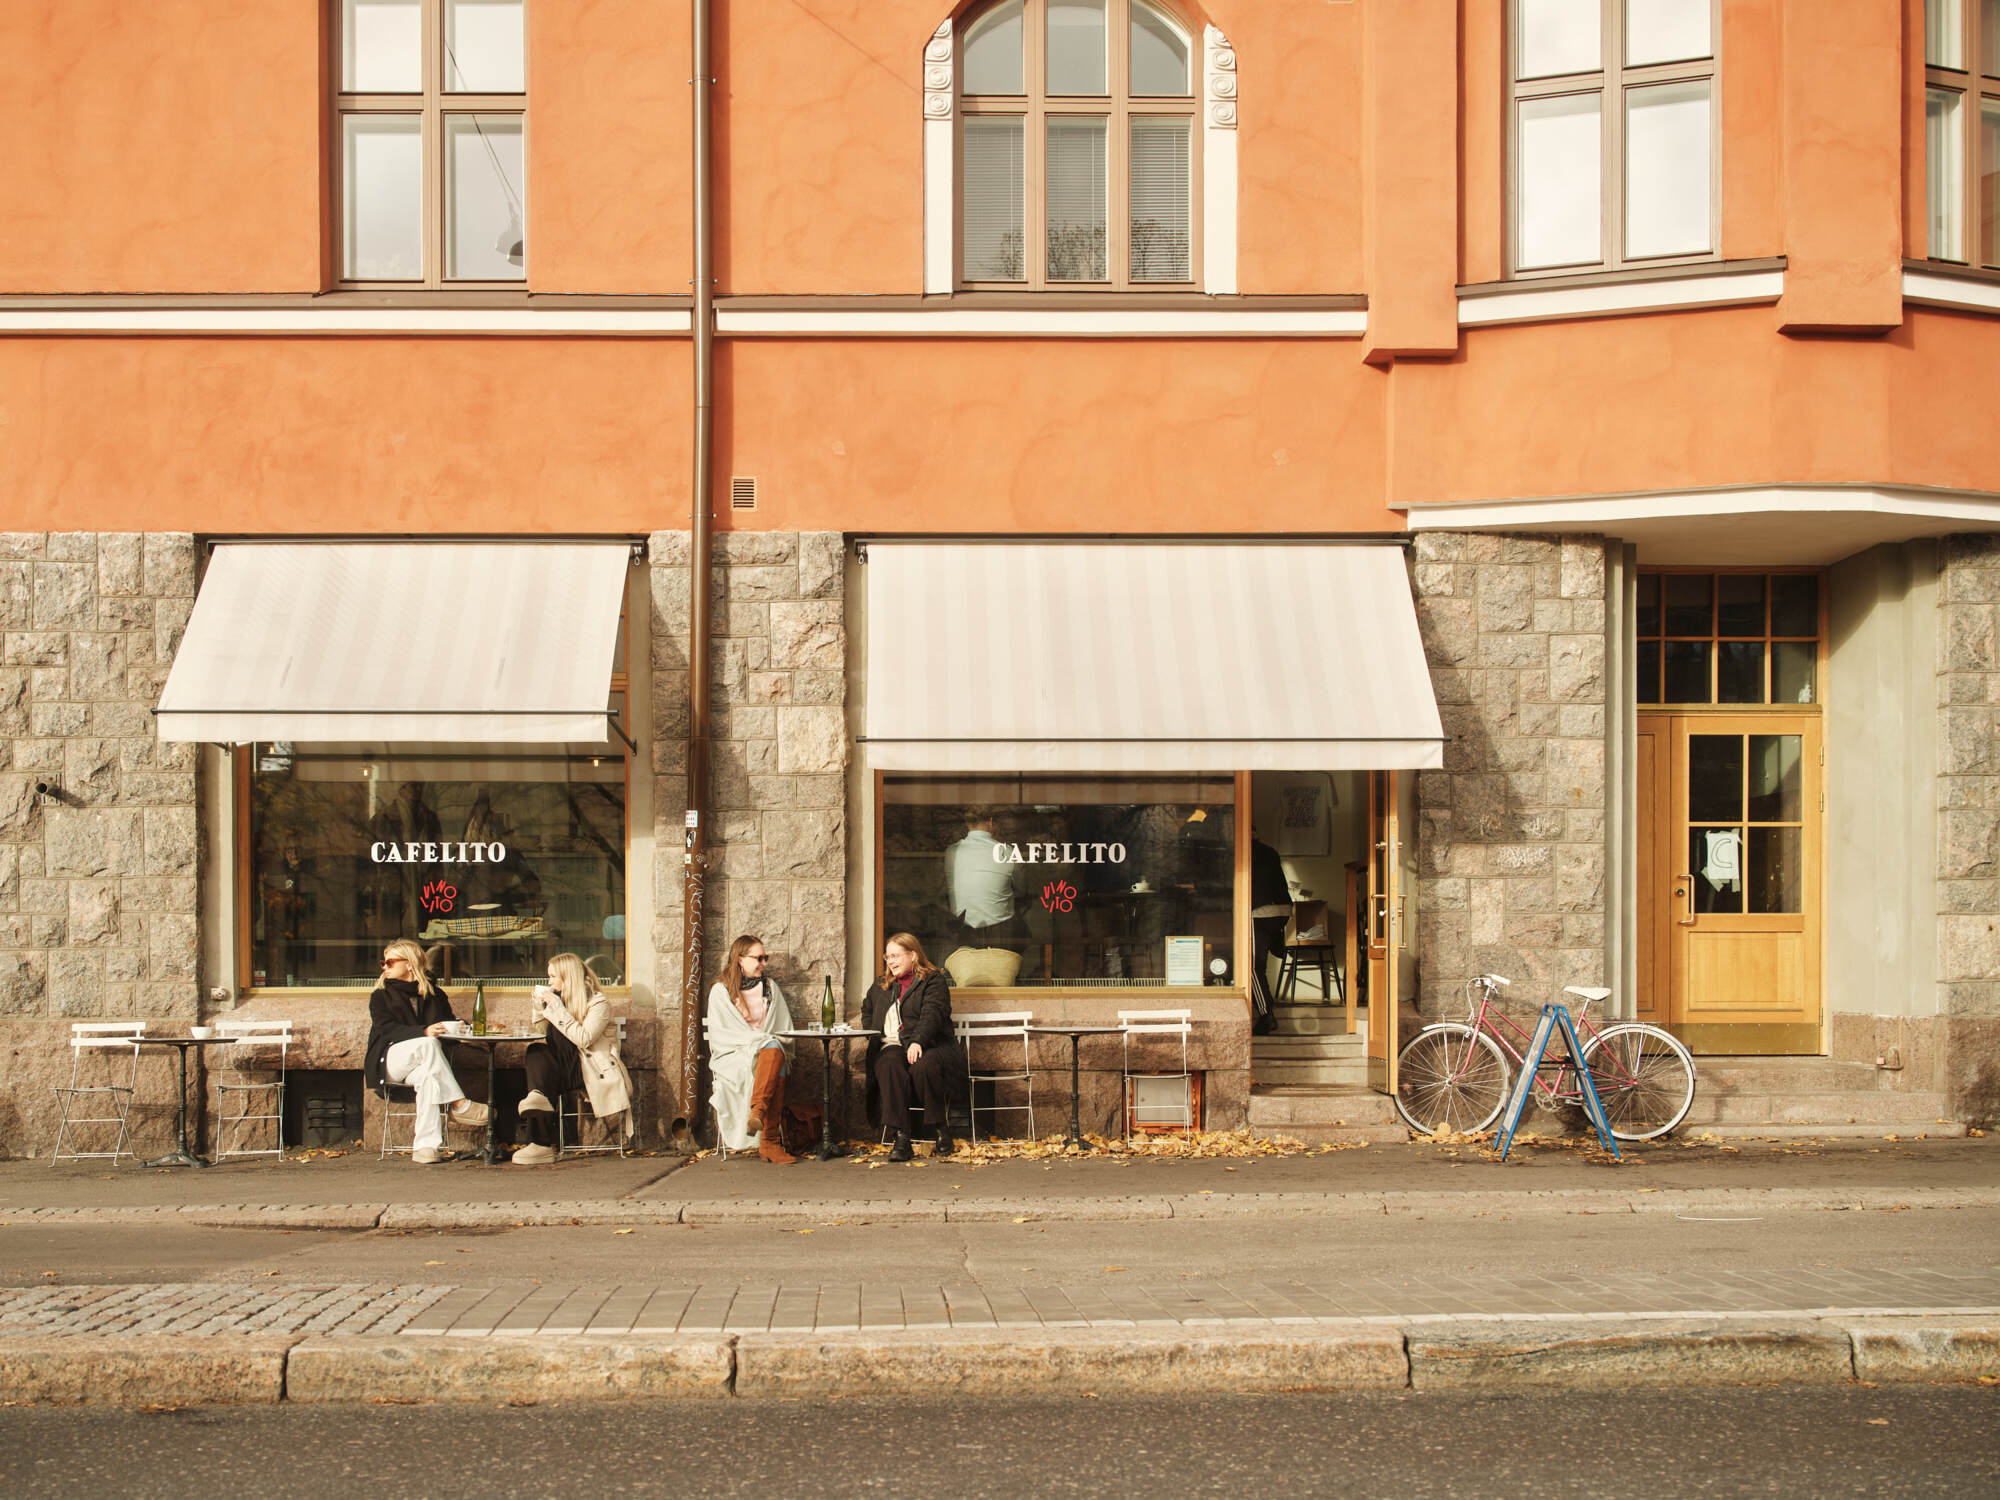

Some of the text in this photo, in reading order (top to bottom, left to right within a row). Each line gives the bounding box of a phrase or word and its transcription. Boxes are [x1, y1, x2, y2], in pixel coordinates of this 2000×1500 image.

[370, 841, 506, 863] CAFELITO
[992, 842, 1127, 864] CAFELITO
[423, 879, 457, 899] VINO
[1043, 879, 1077, 899] VINO
[419, 895, 453, 913] LITO
[1040, 895, 1073, 913] LITO
